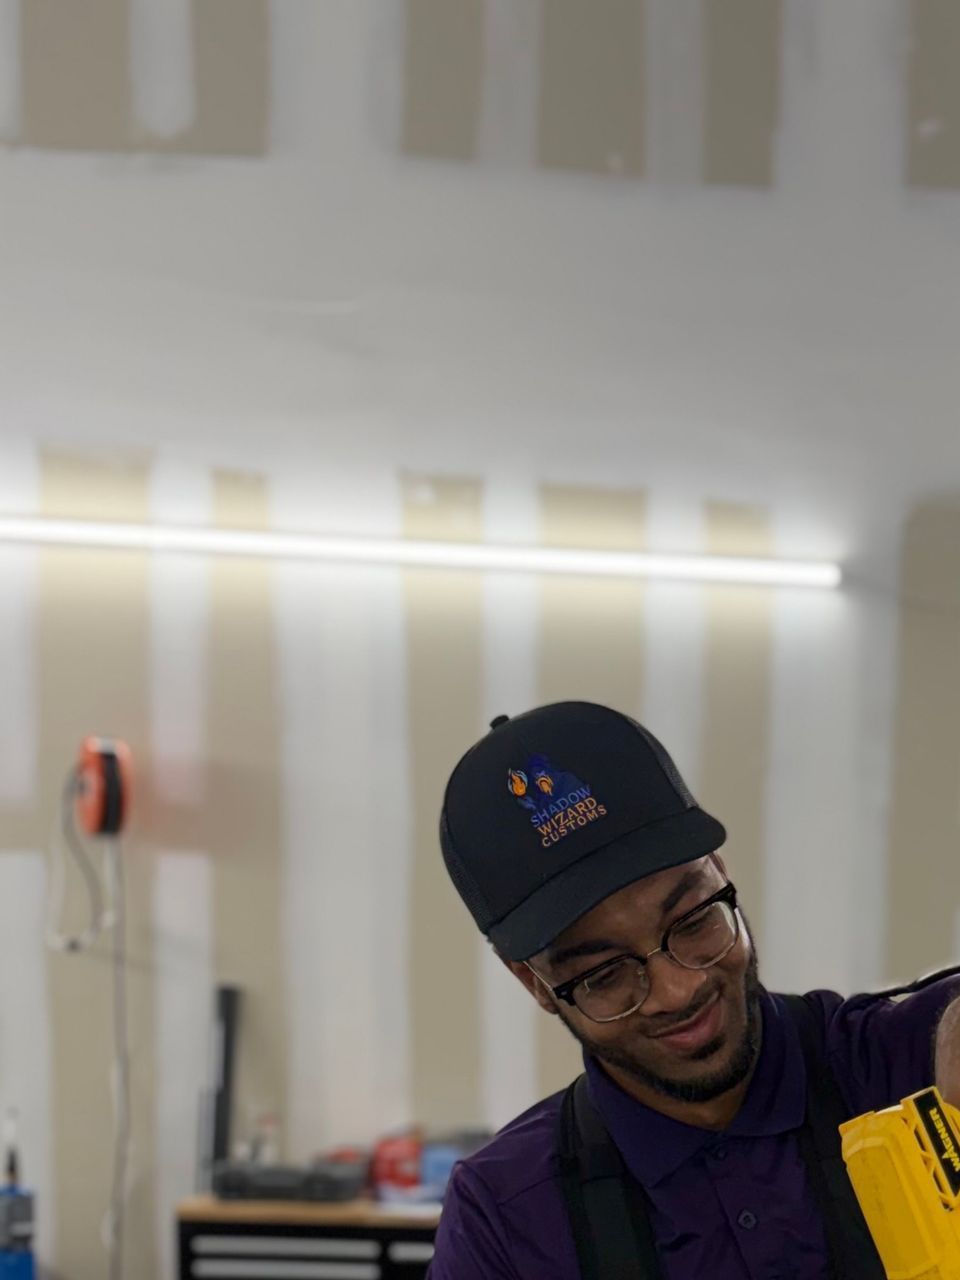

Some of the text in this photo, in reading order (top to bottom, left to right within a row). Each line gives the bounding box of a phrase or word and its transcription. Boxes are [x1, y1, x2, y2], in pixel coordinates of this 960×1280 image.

[531, 785, 591, 828] SHADOW
[537, 797, 598, 837] WIZARD
[542, 805, 607, 848] CUSTOMS
